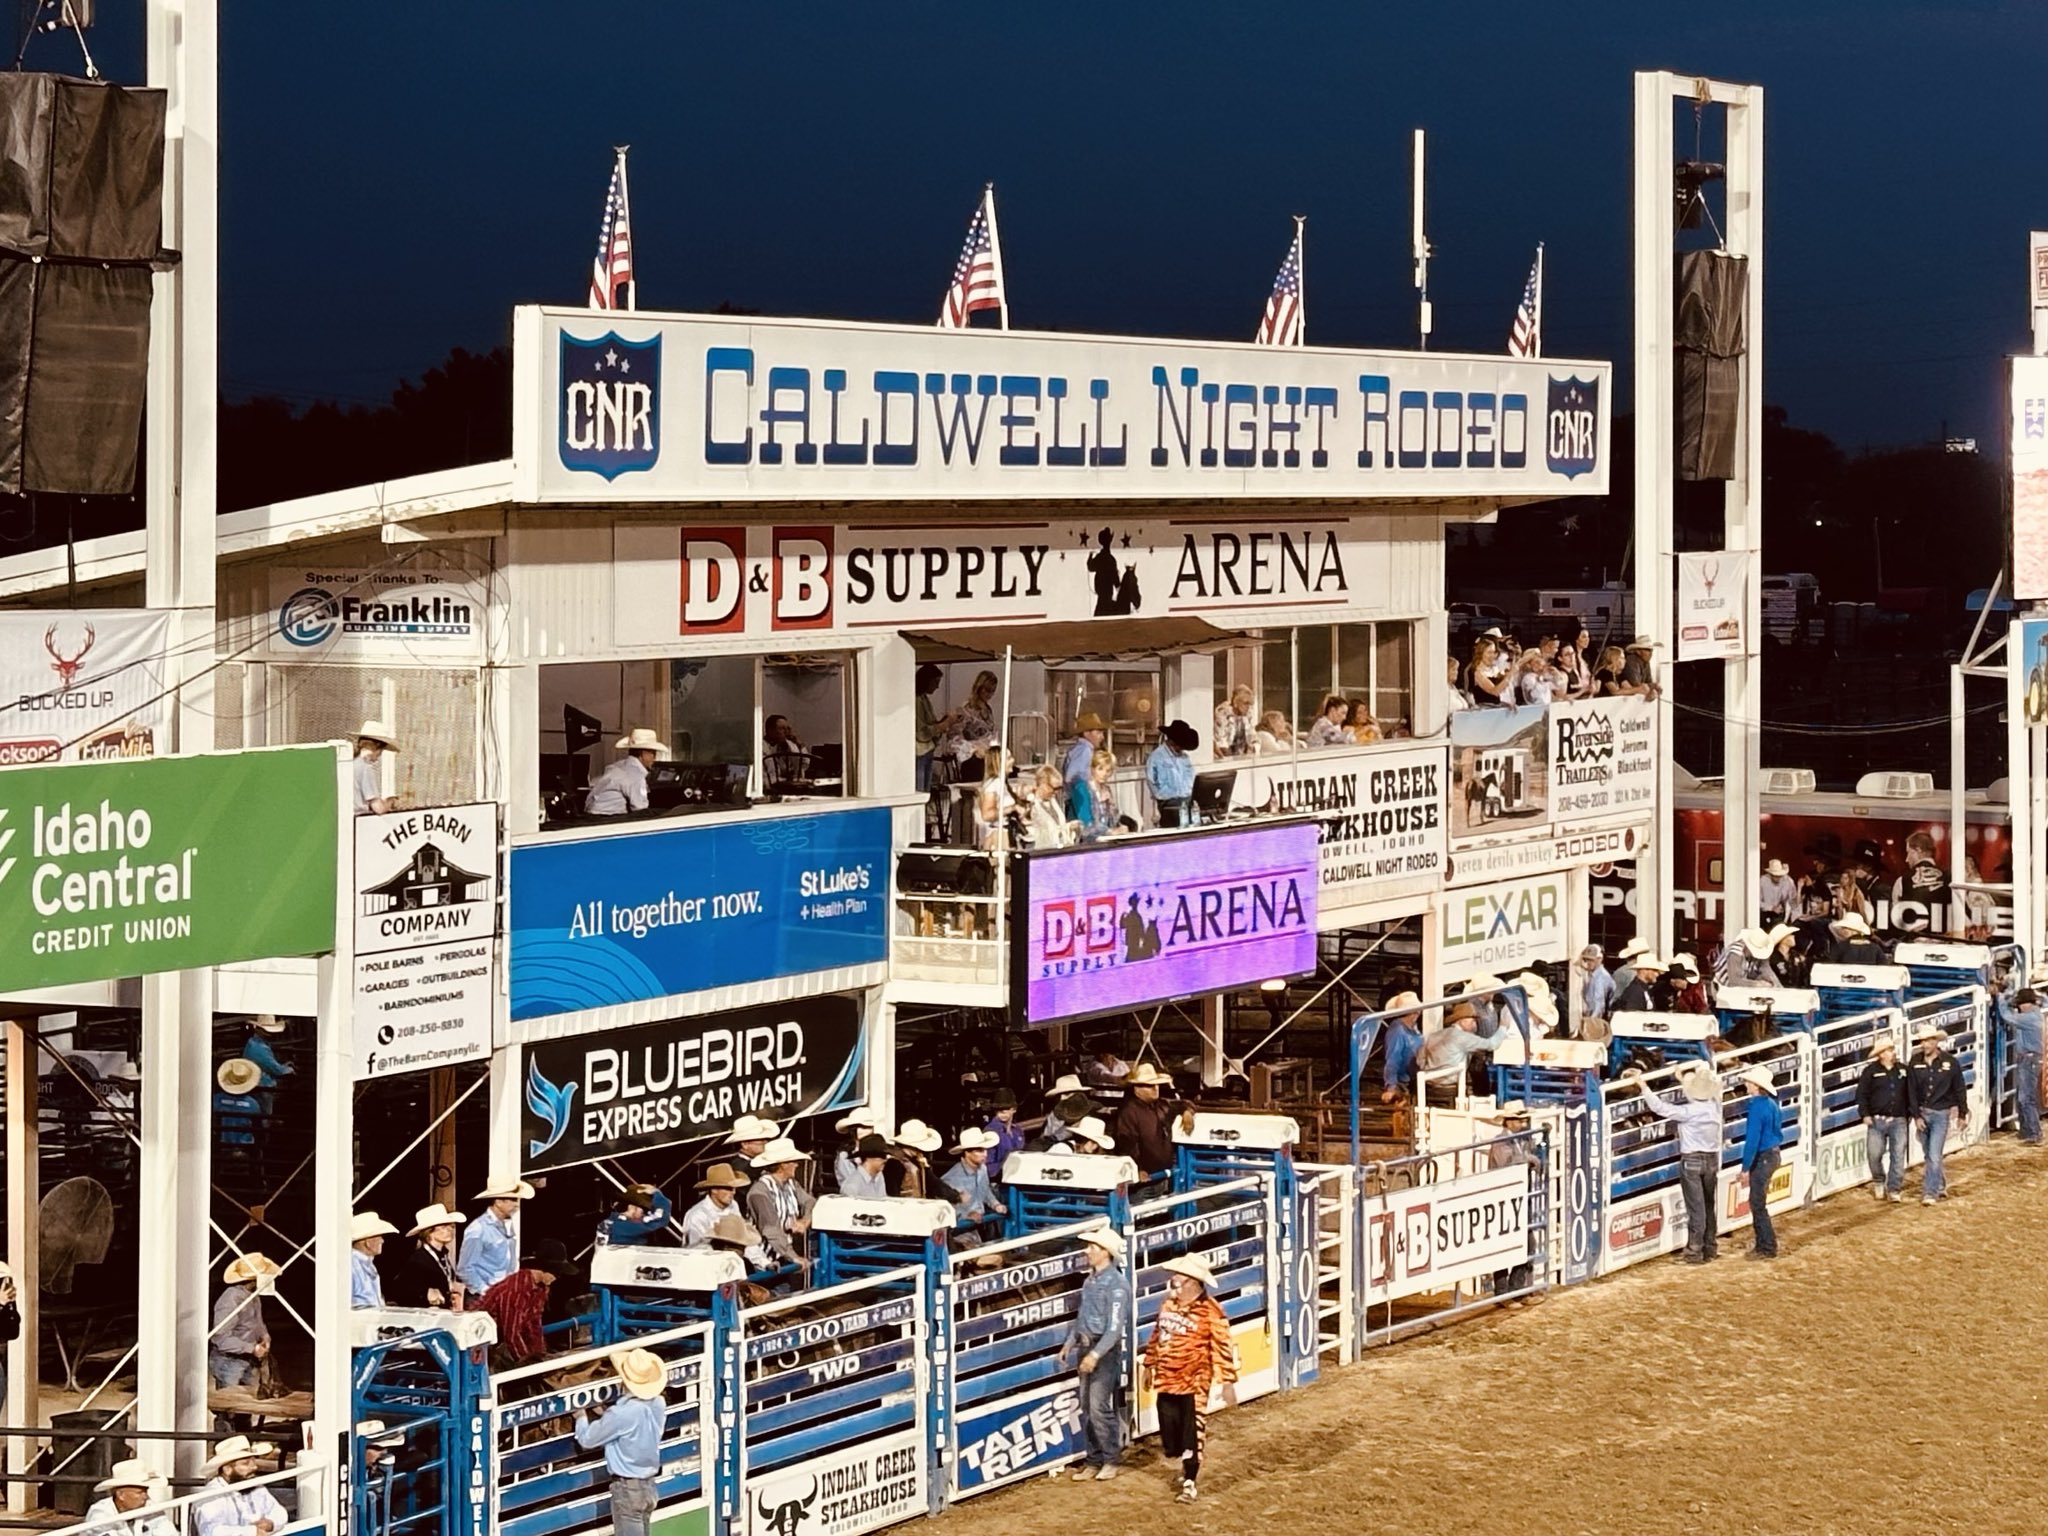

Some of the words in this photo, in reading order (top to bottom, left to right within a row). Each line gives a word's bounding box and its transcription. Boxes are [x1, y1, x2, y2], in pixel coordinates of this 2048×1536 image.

[566, 380, 654, 452] CNR
[704, 346, 1128, 468] CALDWELL
[1151, 365, 1339, 468] NIGHT
[1358, 374, 1528, 469] RODEO
[1548, 409, 1595, 460] CNR
[306, 572, 359, 585] Special
[685, 539, 832, 623] D&B
[846, 545, 1050, 604] SUPPLY
[1169, 530, 1348, 599] ARENA
[342, 596, 470, 624] Franklin
[417, 624, 469, 634] SUPPLY
[19, 692, 87, 711] BUCKED
[91, 690, 113, 708] UP
[1556, 717, 1614, 764] Riverside
[1620, 716, 1650, 734] Caldwell
[1617, 757, 1651, 774] Blackfoot
[1370, 764, 1438, 805] CREEK
[33, 799, 151, 859] Idaho
[382, 816, 419, 850] THE
[423, 813, 472, 844] BARN
[1323, 861, 1372, 885] CALDWELL
[1376, 856, 1403, 876] NIGHT
[1406, 852, 1438, 871] RODEO
[1456, 855, 1483, 875] seven
[1486, 850, 1514, 870] devils
[1517, 843, 1552, 866] whiskey
[1555, 832, 1620, 860] RODEO
[32, 848, 194, 917] Central
[800, 870, 818, 898] St
[820, 864, 870, 895] Luke's
[380, 908, 471, 937] COMPANY
[568, 900, 603, 939] All
[611, 890, 706, 938] together
[712, 889, 763, 919] now.
[811, 901, 844, 920] Health
[845, 898, 867, 917] Plan
[1045, 903, 1116, 957] D&B
[1167, 878, 1307, 947] ARENA
[1442, 883, 1559, 948] LEXAR
[32, 922, 111, 956] CREDIT
[125, 915, 192, 945] UNION
[1473, 941, 1527, 965] HOMES
[365, 960, 390, 973] POLE
[392, 955, 424, 969] BARNS
[421, 966, 488, 985] OUTBUILDINGS
[1042, 953, 1118, 978] SUPPLY
[384, 990, 464, 1011] BARNDOMINIUMS
[583, 1096, 682, 1145] EXPRESS
[688, 1089, 732, 1125] CAR
[738, 1071, 802, 1114] WASH
[1639, 1123, 1666, 1142] FIVE
[1589, 1109, 1601, 1204] CALDWELL
[1570, 1120, 1588, 1263] 100
[1176, 1218, 1210, 1241] 100
[1437, 1196, 1524, 1252] SUPPLY
[1611, 1206, 1662, 1233] COMMERCIAL
[1627, 1226, 1646, 1241] TIRE
[1281, 1197, 1294, 1304] CALDWELL
[1002, 1265, 1039, 1289] 100
[1039, 1259, 1064, 1278] YEARS
[1297, 1197, 1315, 1357] 100
[1002, 1298, 1065, 1329] THREE
[1283, 1309, 1293, 1337] ID
[761, 1338, 783, 1353] 1924
[798, 1319, 840, 1345] 100
[840, 1311, 869, 1333] YEARS
[933, 1289, 948, 1413] CALDWELL
[667, 1367, 687, 1382] 024
[808, 1354, 860, 1385] TWO
[519, 1405, 543, 1420] 1924
[558, 1384, 612, 1412] 100
[720, 1346, 736, 1478] CALDWELL
[935, 1424, 946, 1449] ID
[959, 1389, 1080, 1471] TATES
[821, 1459, 868, 1500] INDIAN
[875, 1445, 916, 1483] CREEK
[723, 1486, 732, 1517] ID
[820, 1476, 917, 1526] STEAKHOUSE
